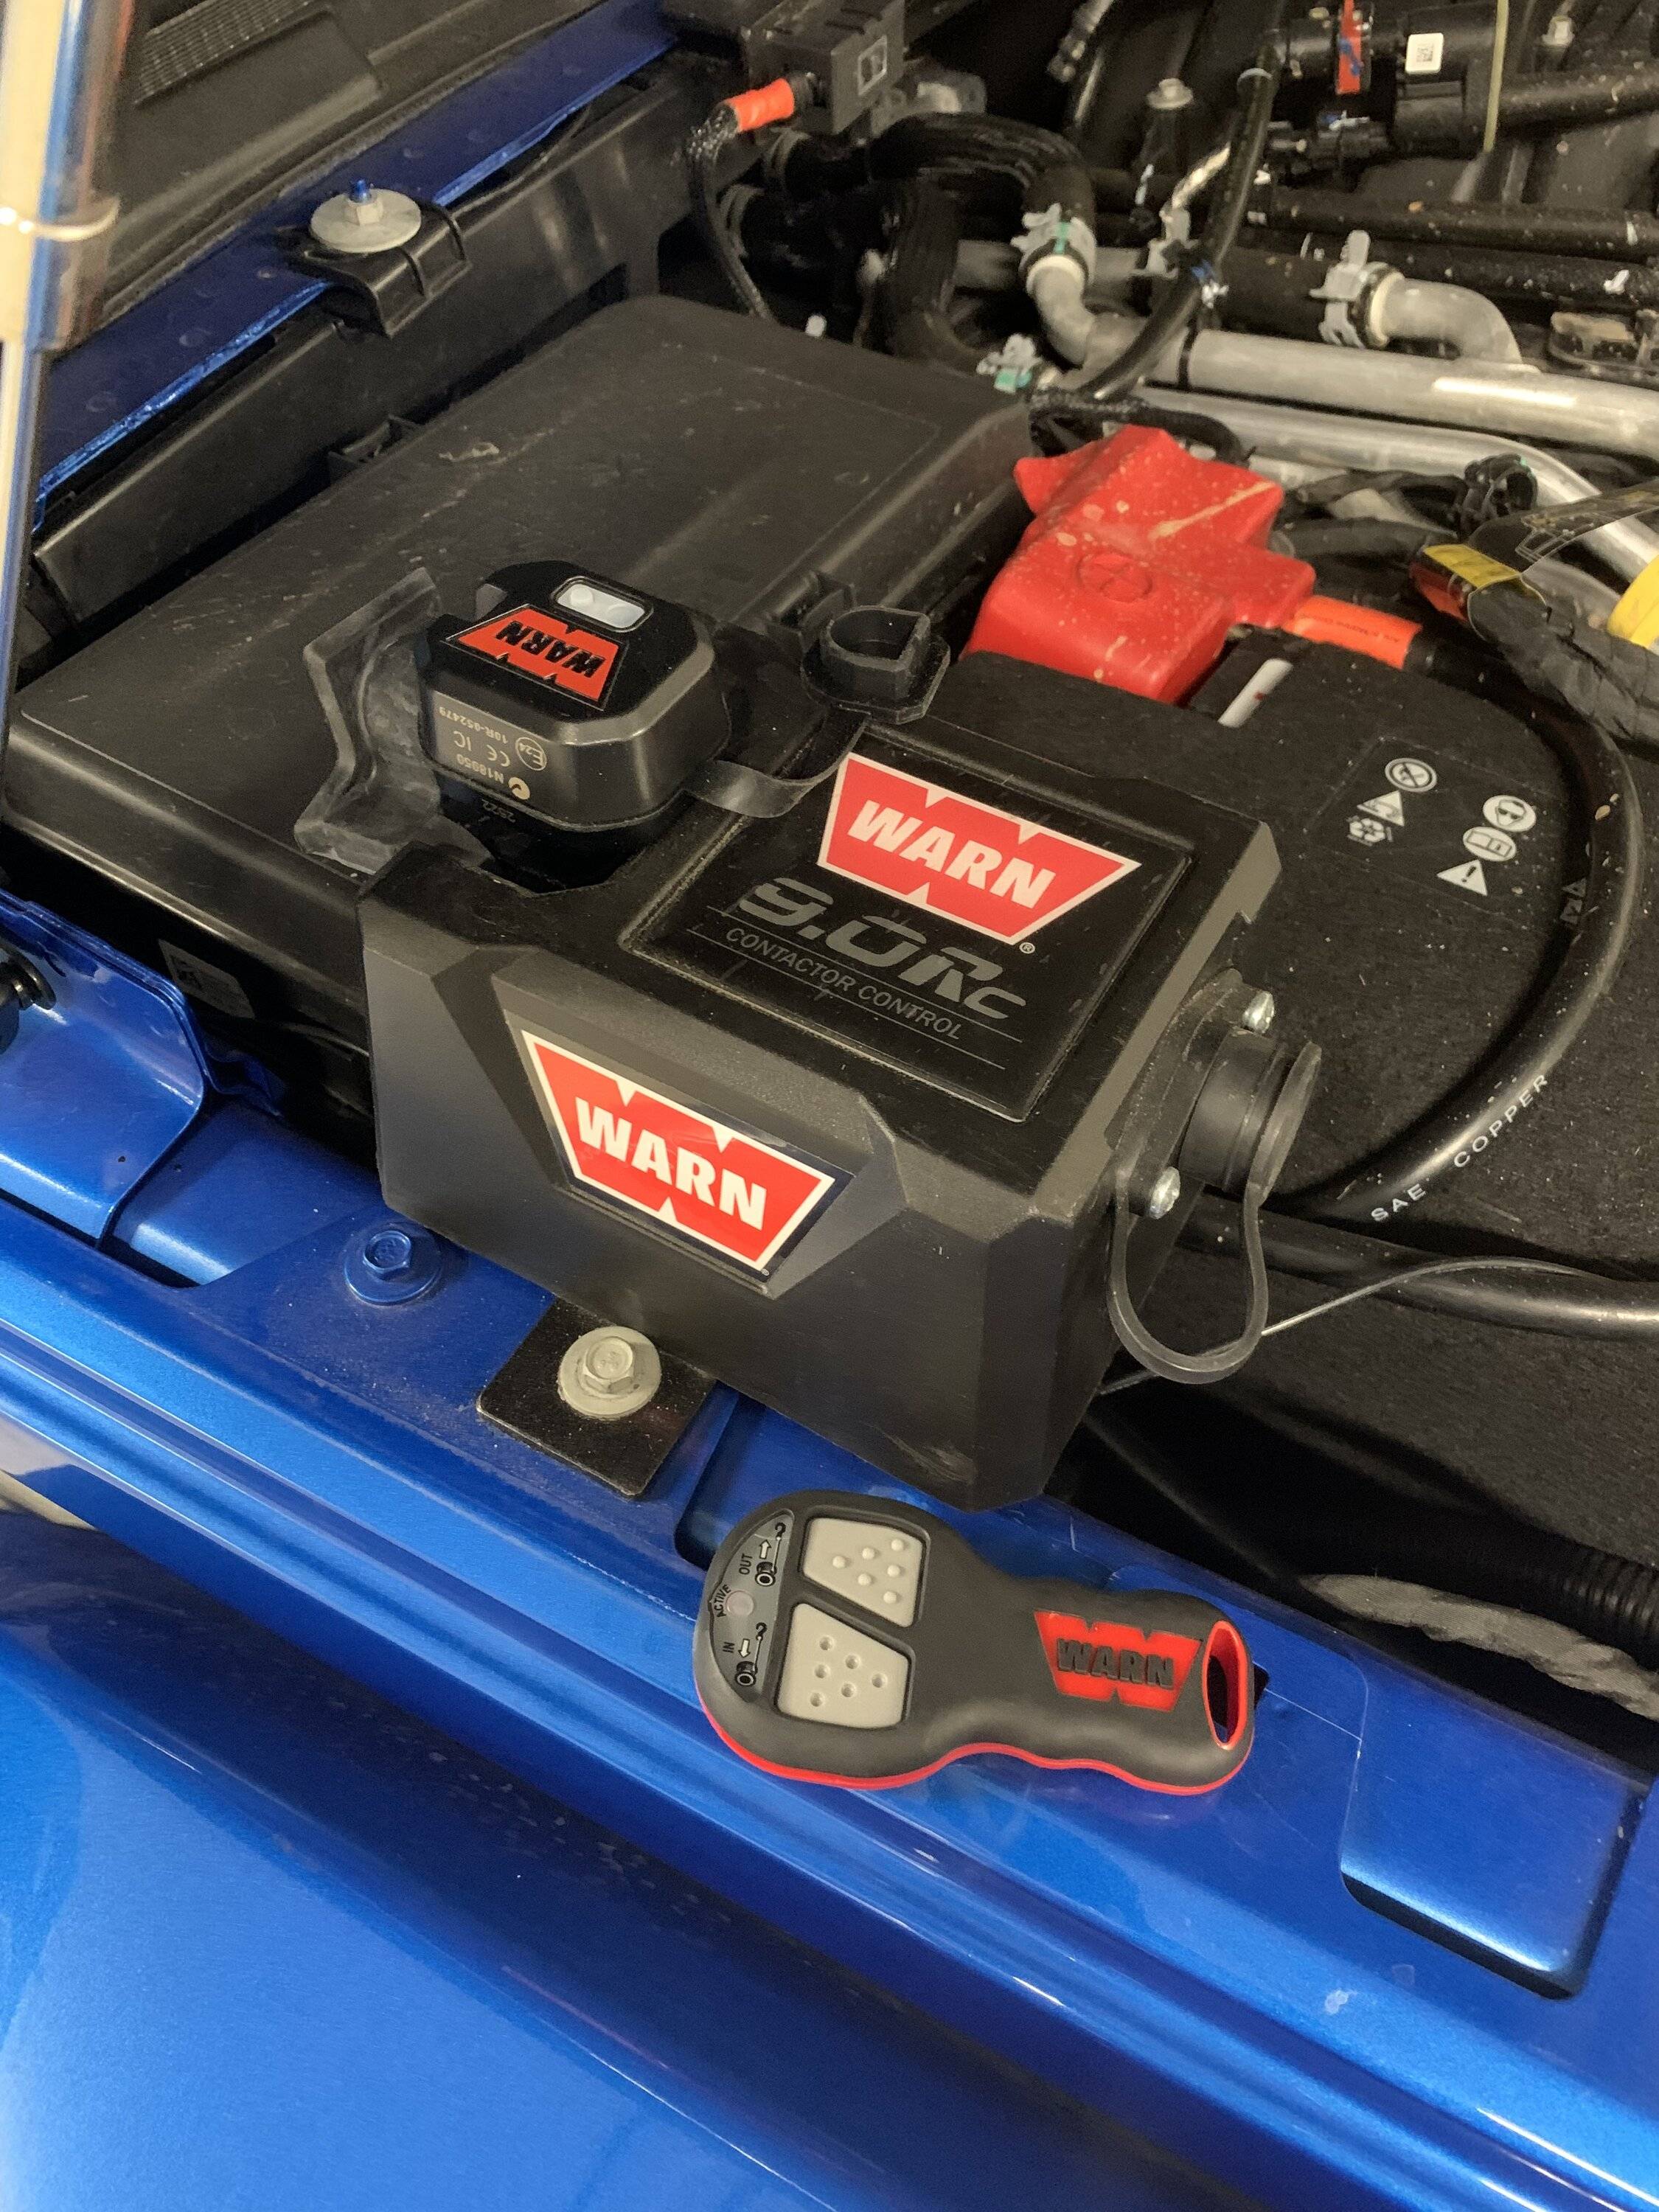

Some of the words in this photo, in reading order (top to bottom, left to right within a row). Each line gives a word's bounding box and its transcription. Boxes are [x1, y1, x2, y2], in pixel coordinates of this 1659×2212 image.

[495, 620, 605, 678] WARN
[847, 800, 1056, 909] WARN
[725, 927, 855, 994] CONTACTOR
[858, 984, 963, 1040] CONTROL
[575, 1096, 768, 1231] WARN
[1371, 1183, 1426, 1223] SAE
[1453, 1073, 1550, 1169] COPPER
[739, 1554, 753, 1575] OUT
[714, 1585, 731, 1618] ACTIVE
[722, 1641, 735, 1654] IN
[1057, 1638, 1175, 1690] WARN
